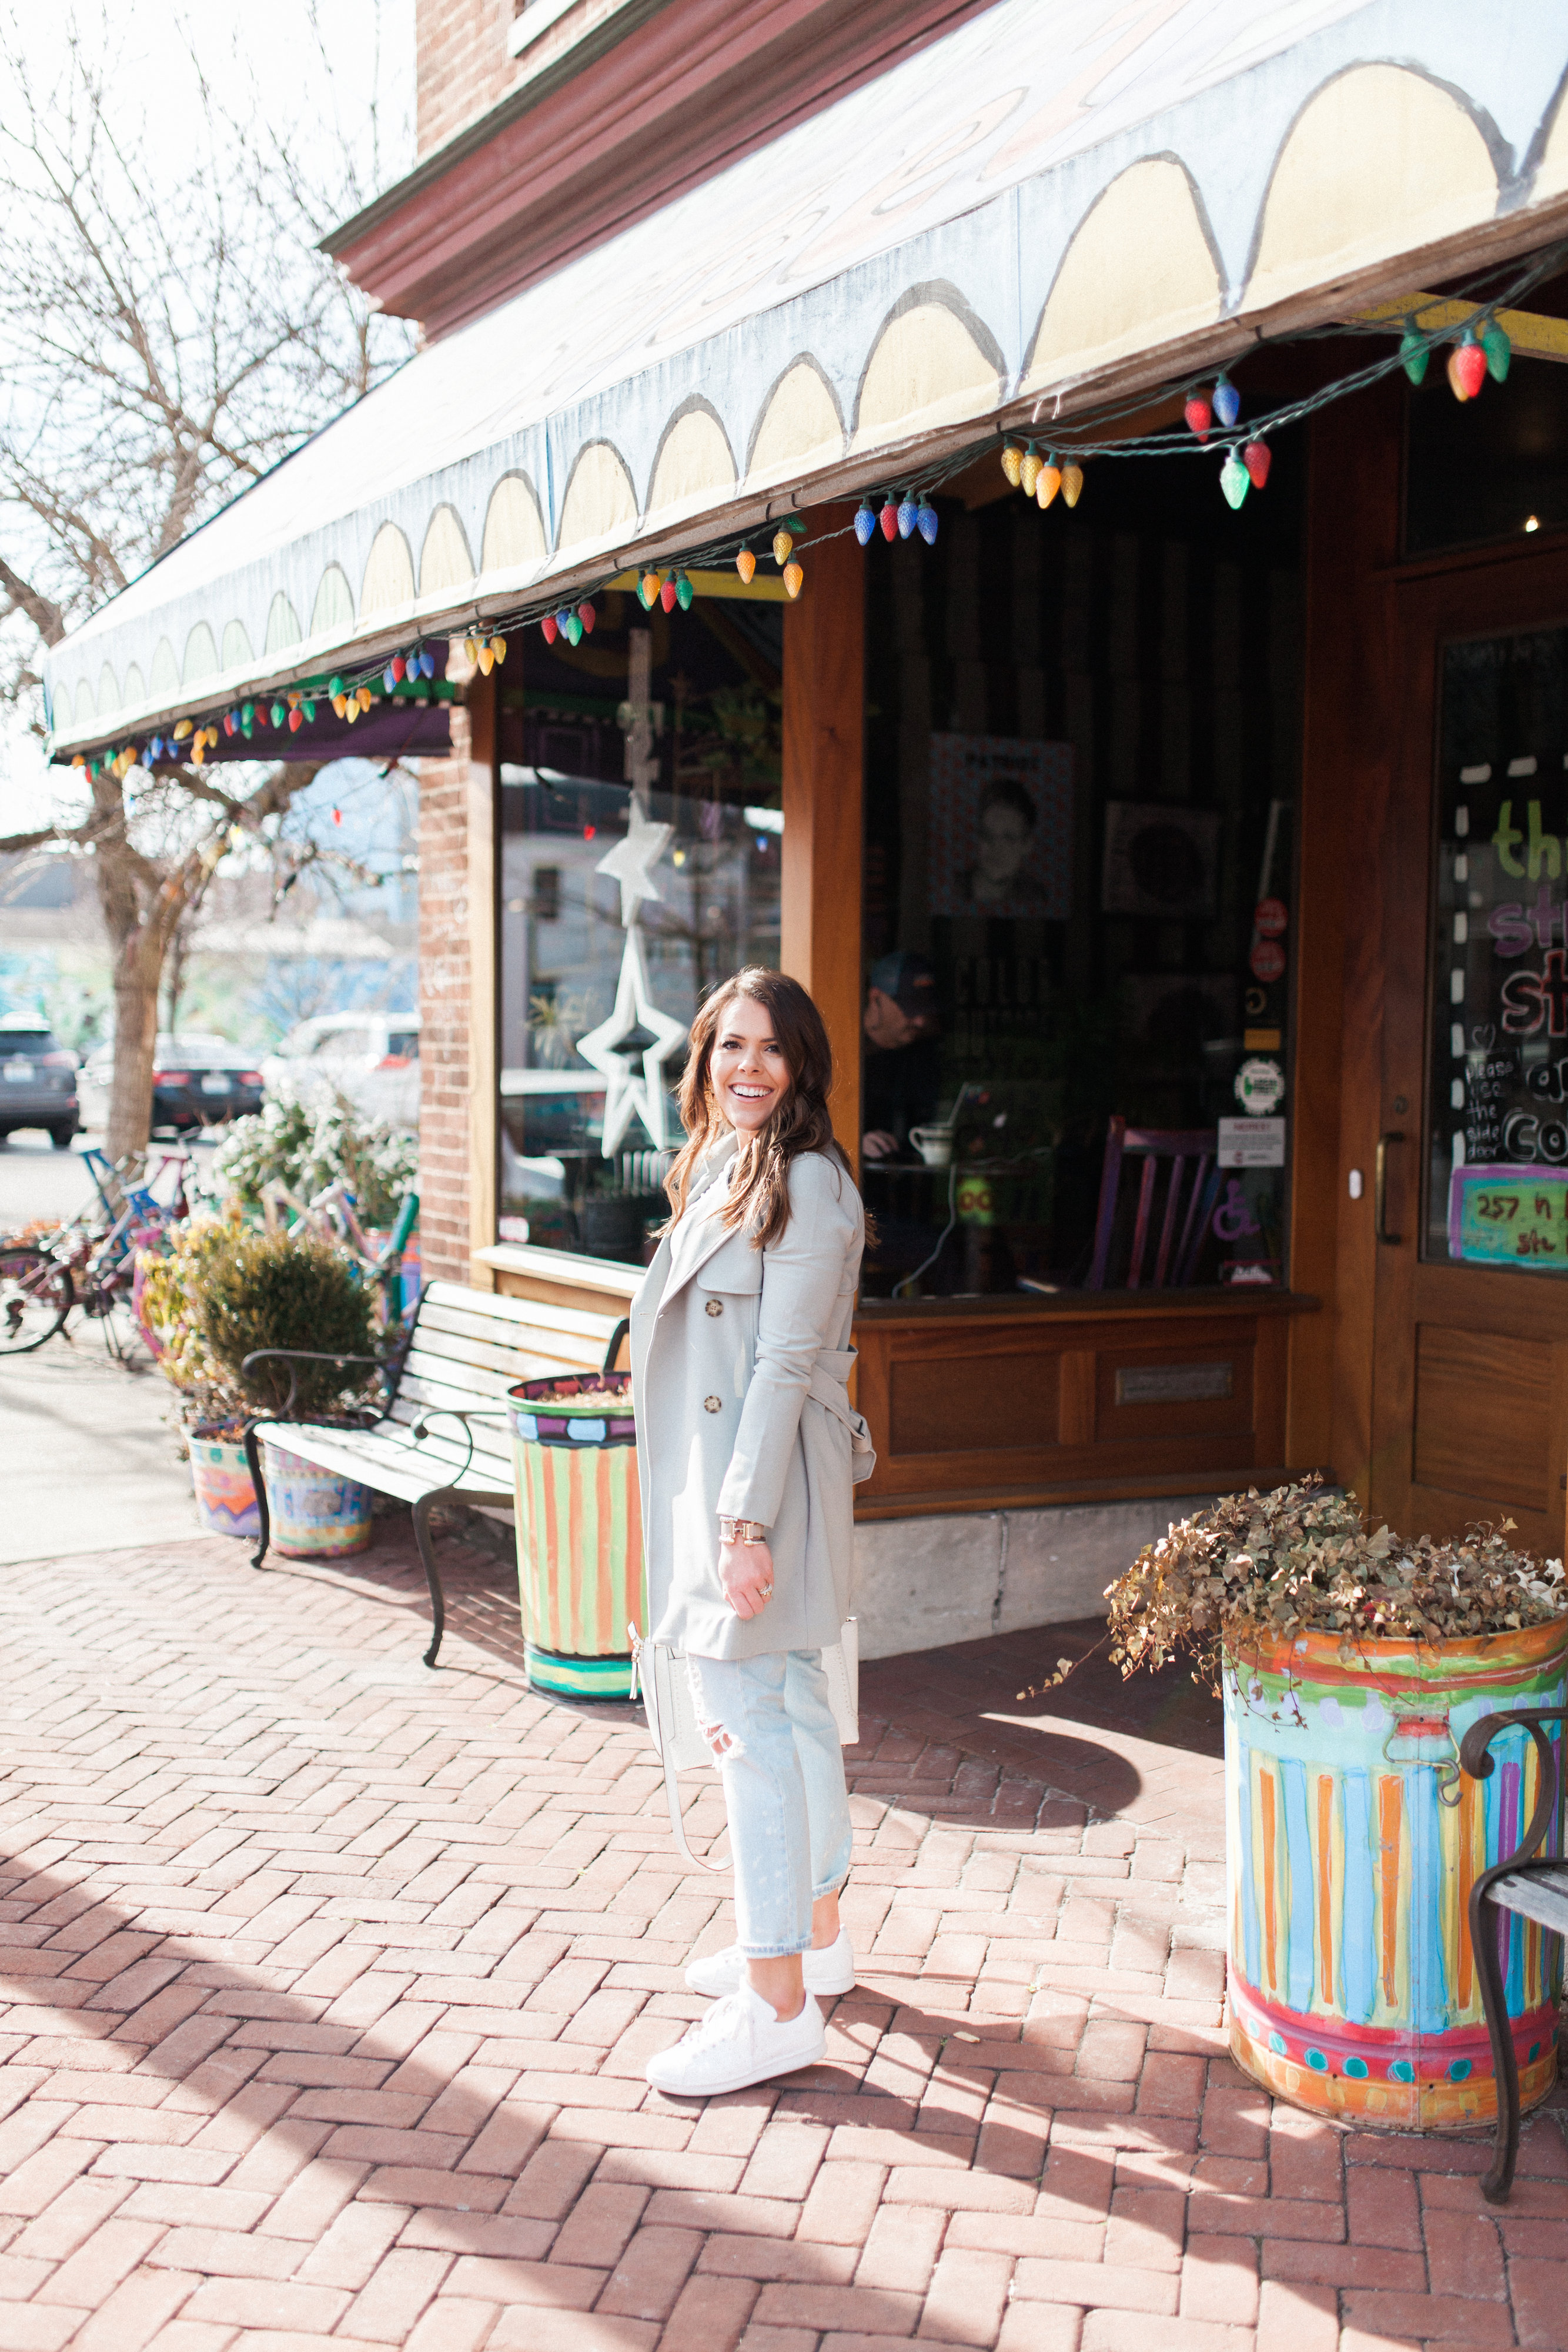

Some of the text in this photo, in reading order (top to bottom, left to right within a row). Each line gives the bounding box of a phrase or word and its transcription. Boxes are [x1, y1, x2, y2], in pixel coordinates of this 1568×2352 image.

[1492, 800, 1568, 881] th
[1488, 887, 1568, 957] st
[1466, 1098, 1498, 1124] the
[1477, 1192, 1520, 1221] 257
